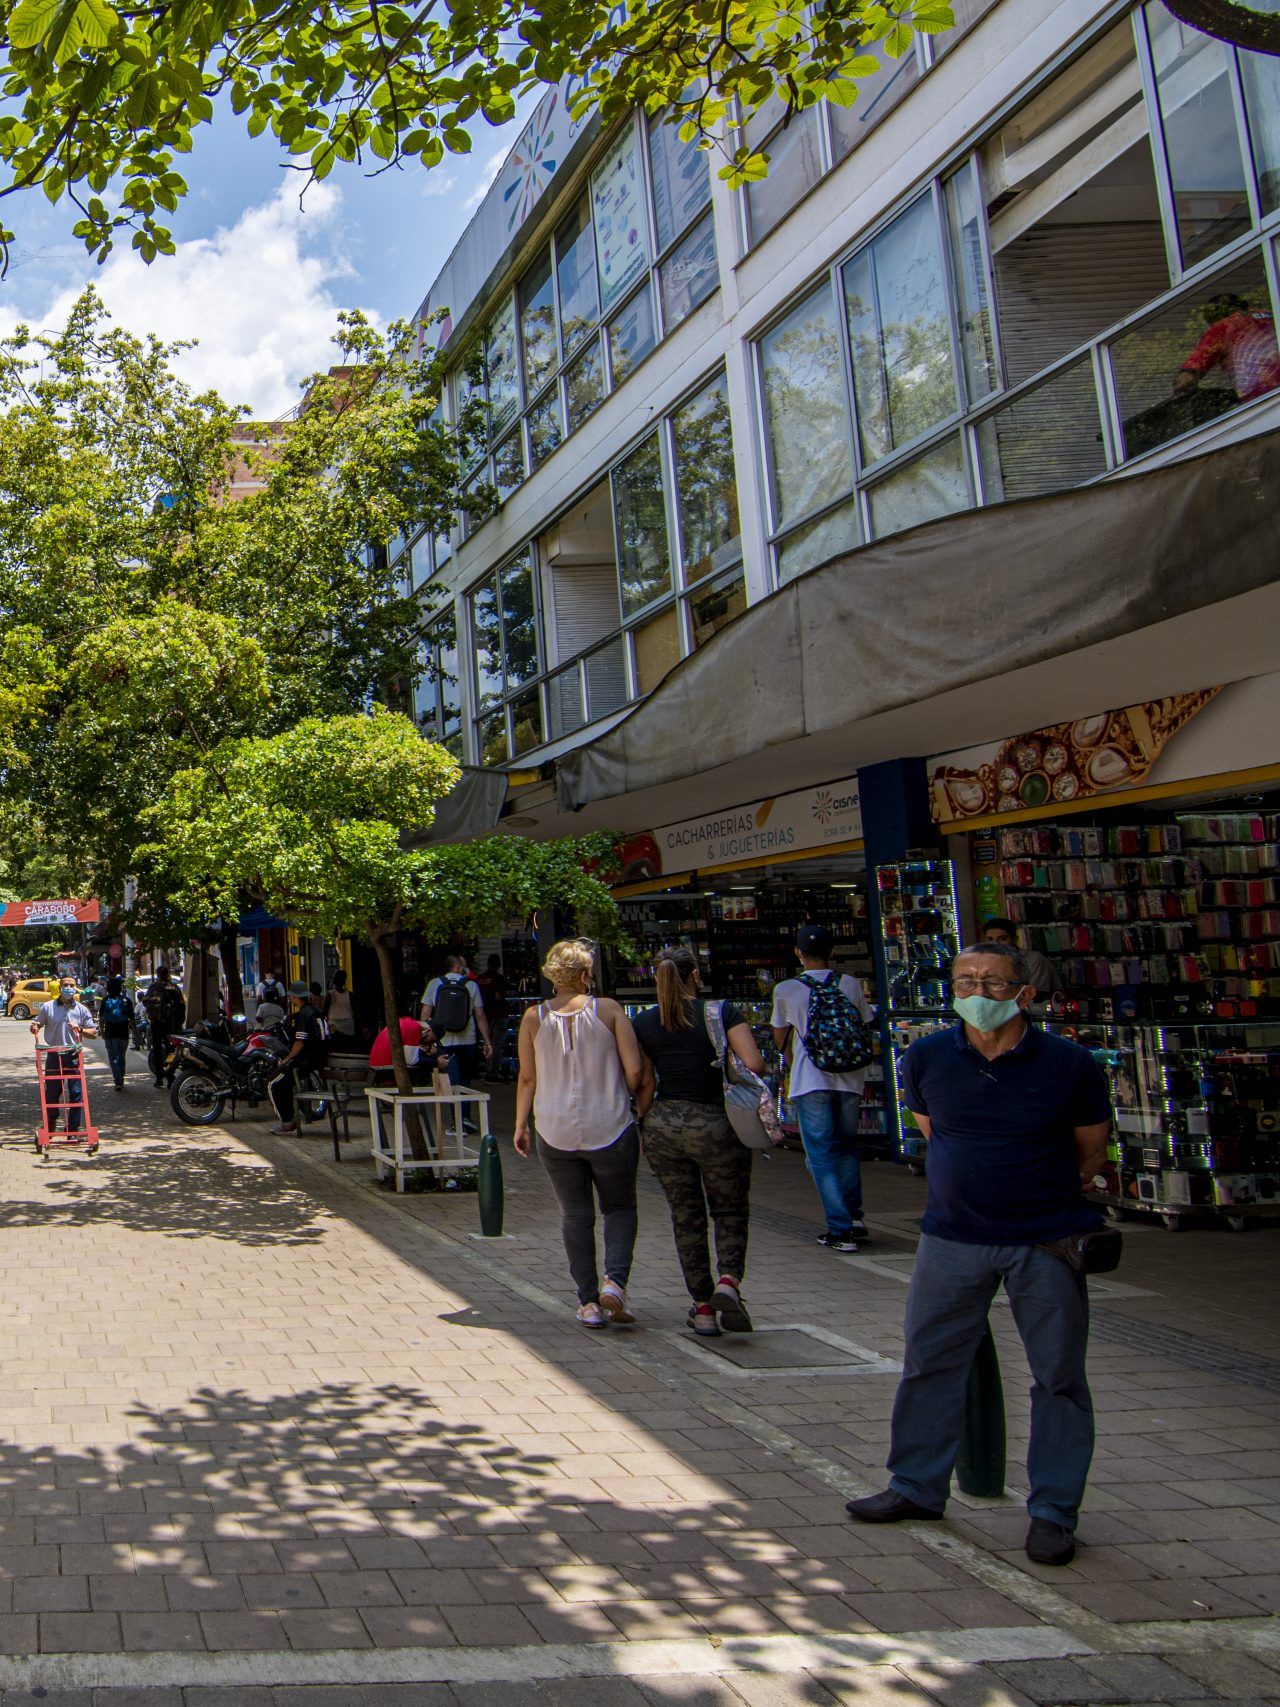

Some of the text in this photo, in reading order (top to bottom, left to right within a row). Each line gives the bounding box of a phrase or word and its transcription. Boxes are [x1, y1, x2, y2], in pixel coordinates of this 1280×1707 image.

[833, 794, 859, 810] cisne
[667, 814, 754, 848] CACHARRERÍAS
[707, 827, 795, 860] & JUGUETERÍAS
[25, 904, 76, 915] CARABOBO
